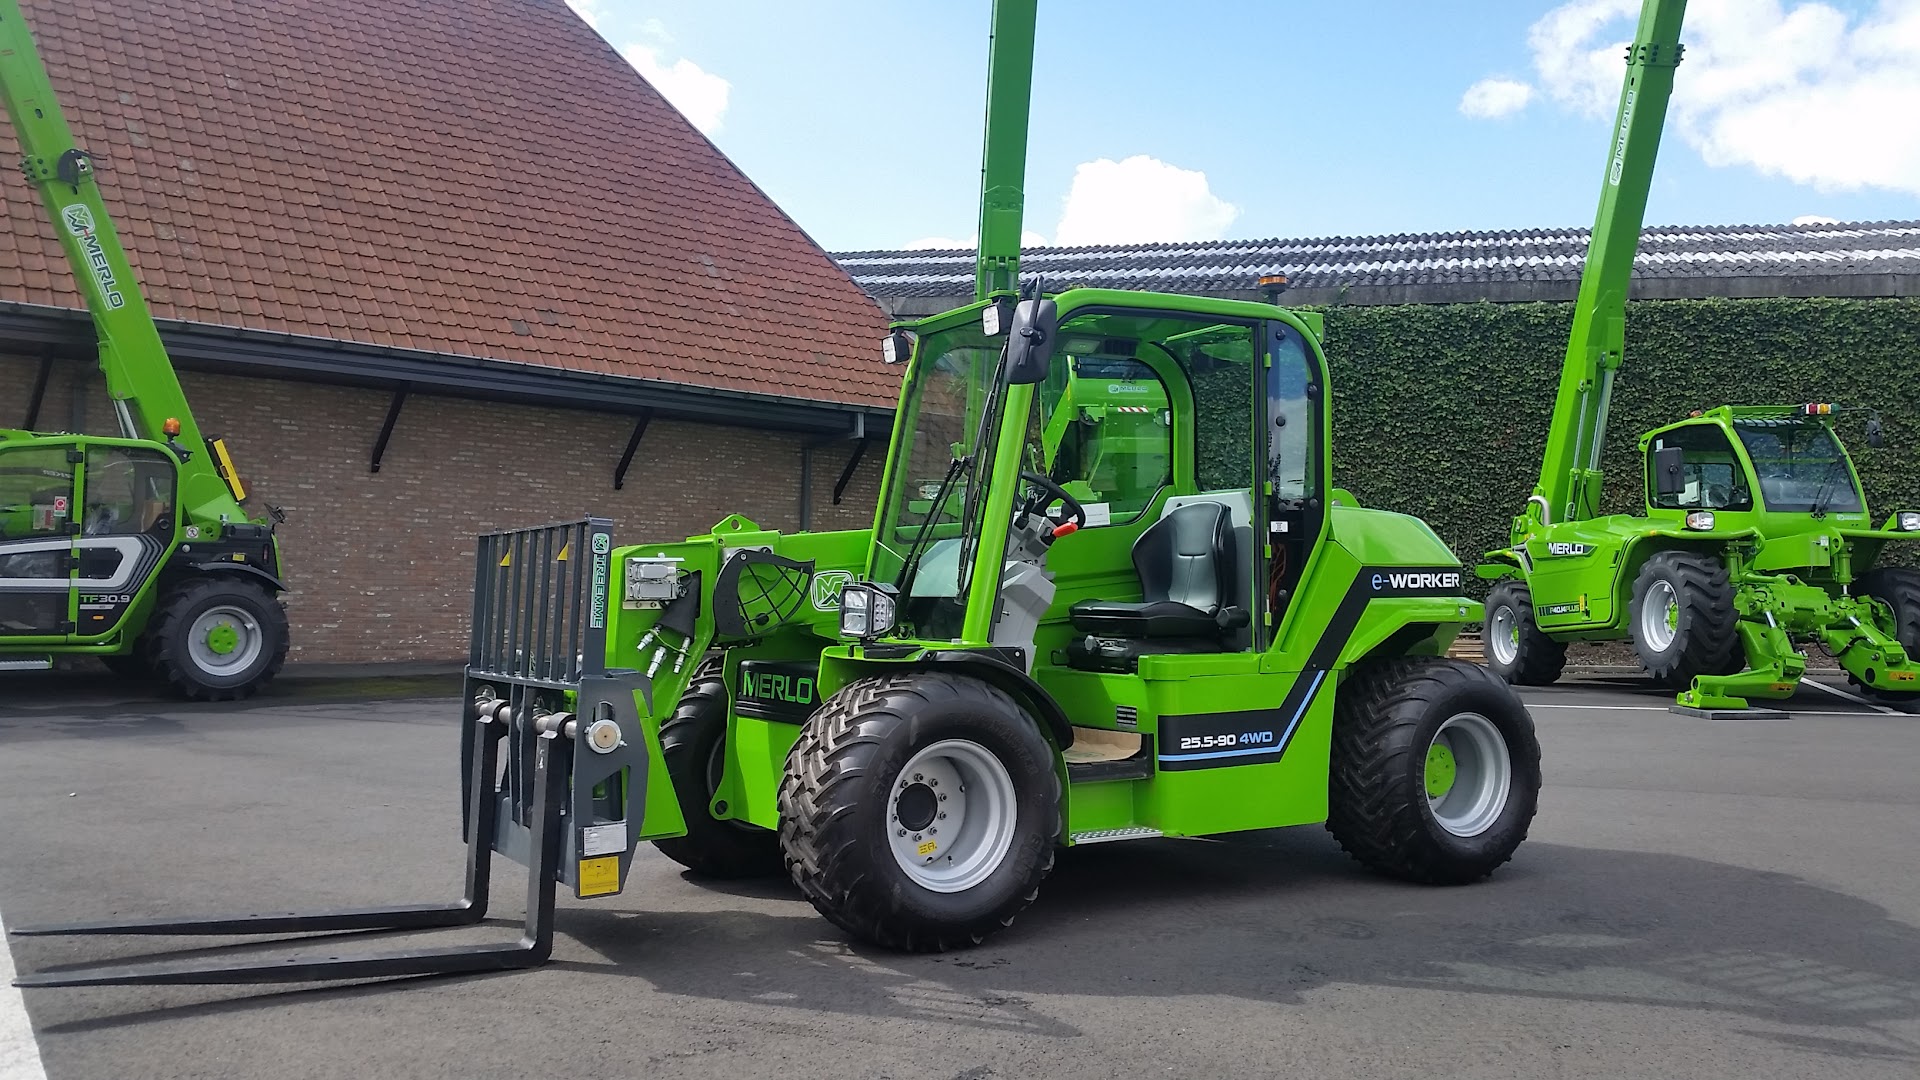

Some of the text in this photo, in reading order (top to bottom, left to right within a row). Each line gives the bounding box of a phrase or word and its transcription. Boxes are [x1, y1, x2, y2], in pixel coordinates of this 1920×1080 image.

[84, 234, 124, 308] MERLO
[1548, 542, 1584, 555] MERLO
[593, 554, 606, 629] TREEMME
[1371, 573, 1460, 591] e-WORKER
[80, 594, 130, 603] TF30.9
[742, 670, 813, 705] MERLO
[1180, 731, 1273, 750] 25.5-90 4WD
